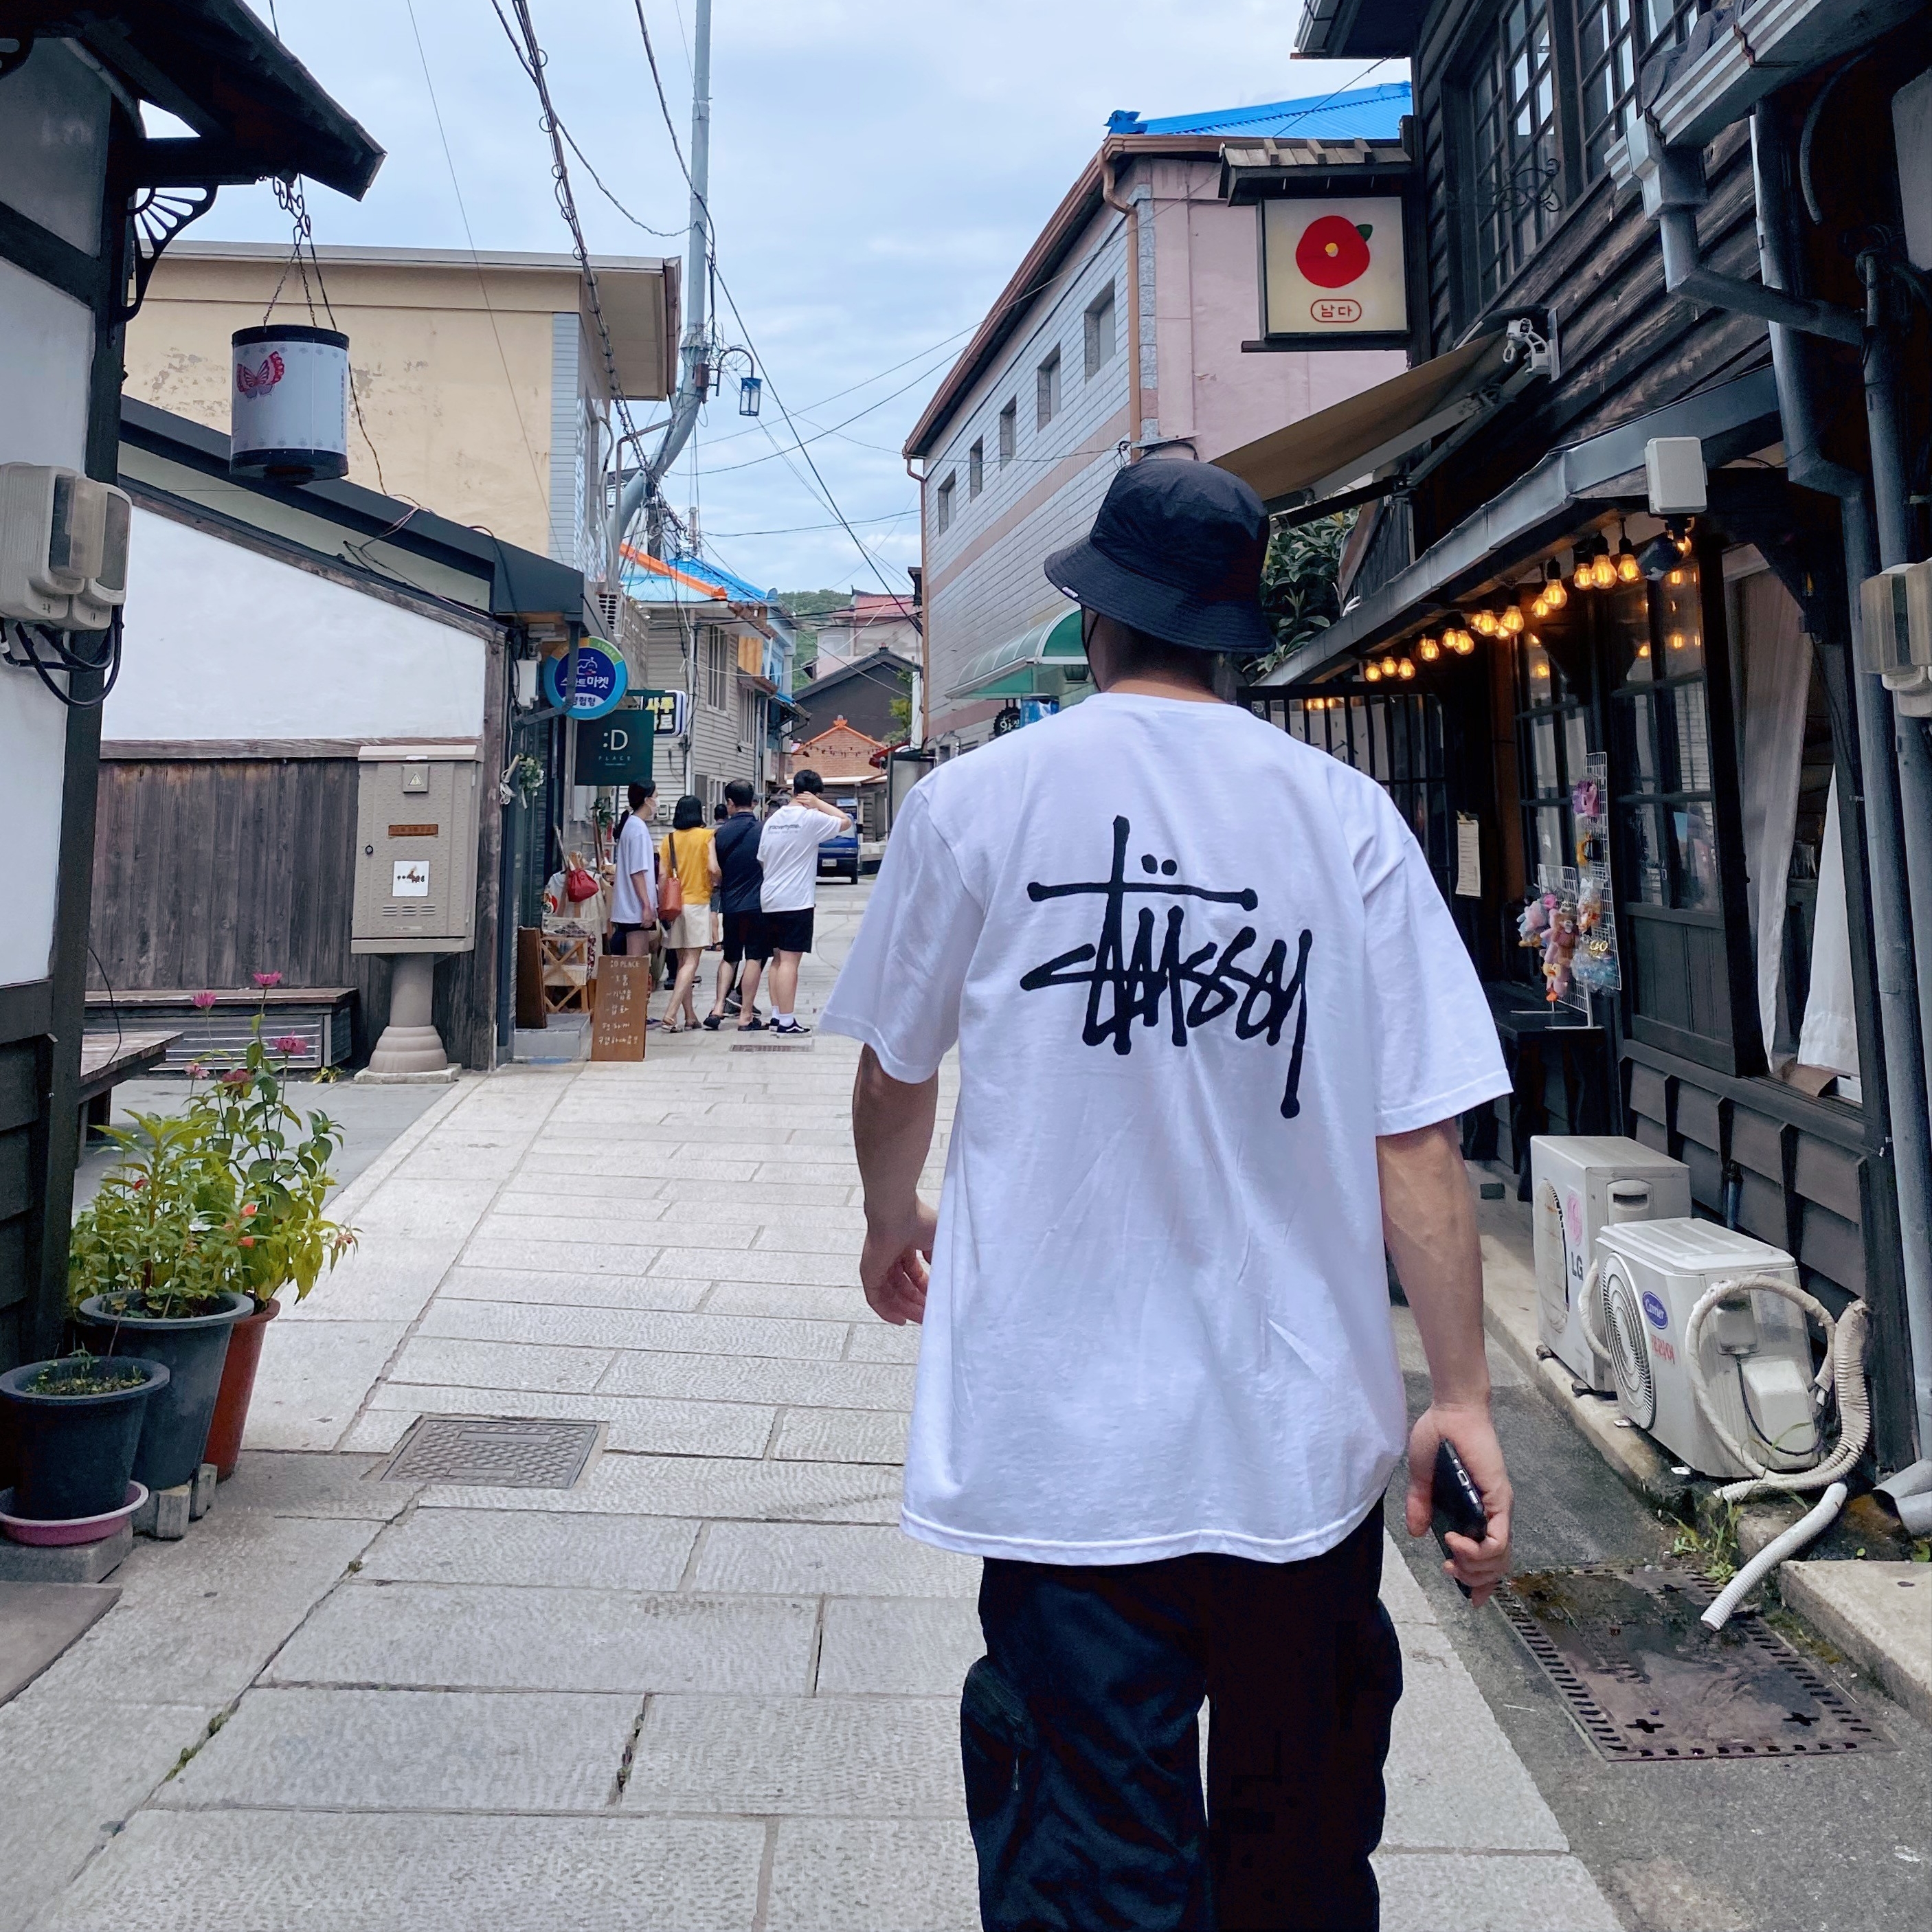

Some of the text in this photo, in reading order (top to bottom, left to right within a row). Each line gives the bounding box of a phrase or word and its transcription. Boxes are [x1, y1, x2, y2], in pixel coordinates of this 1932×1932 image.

[1321, 304, 1352, 317] 남다
[560, 676, 609, 688] 스트마켓
[645, 697, 675, 714] 사주
[1571, 1251, 1583, 1281] LG
